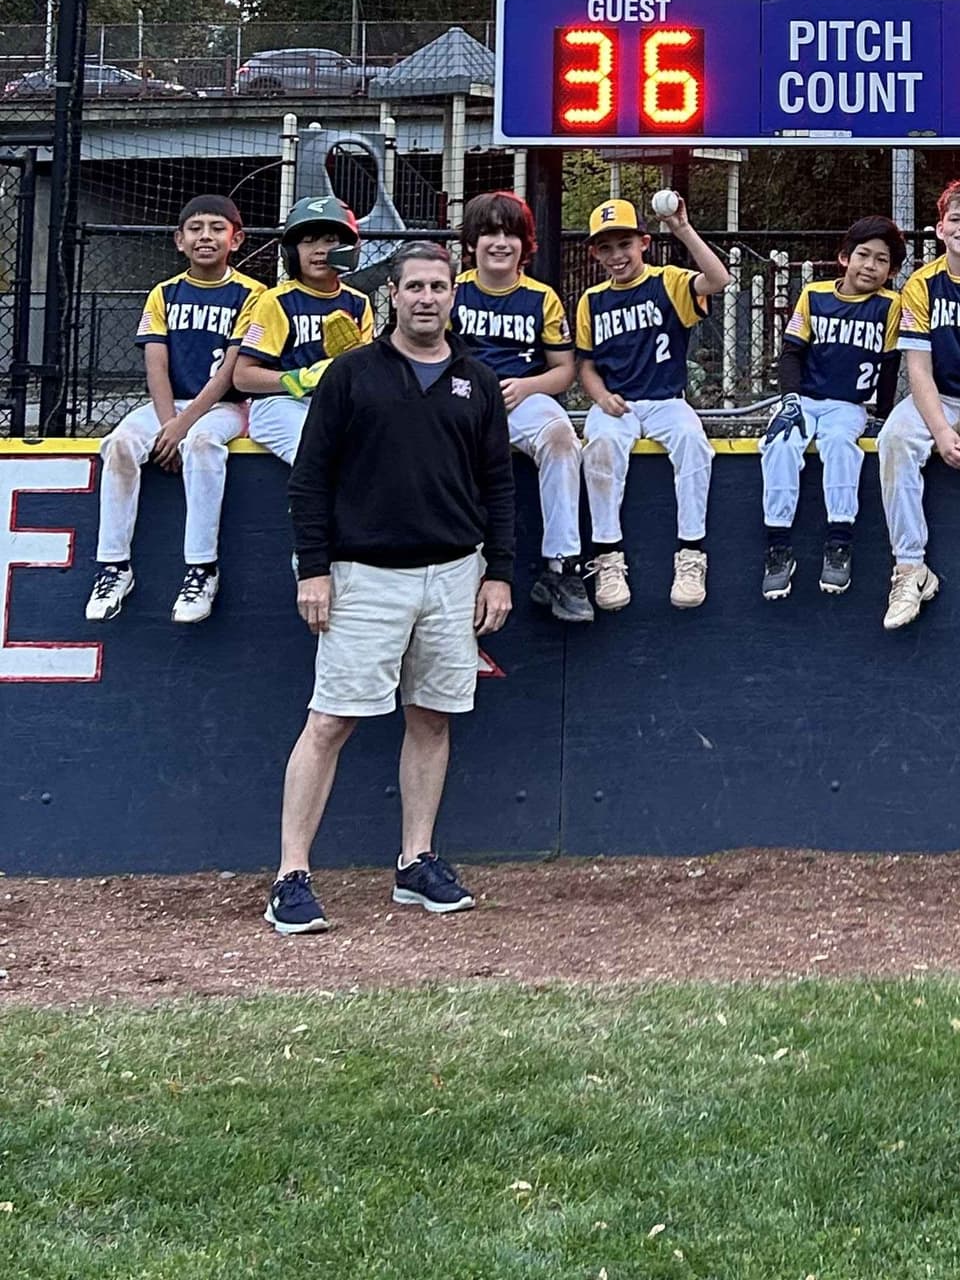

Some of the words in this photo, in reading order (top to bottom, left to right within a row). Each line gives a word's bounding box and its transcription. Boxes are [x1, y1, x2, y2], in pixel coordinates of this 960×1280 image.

[789, 20, 911, 62] PITCH
[564, 30, 699, 123] 36
[778, 71, 924, 114] COUNT
[601, 205, 615, 223] E
[655, 332, 672, 364] 2
